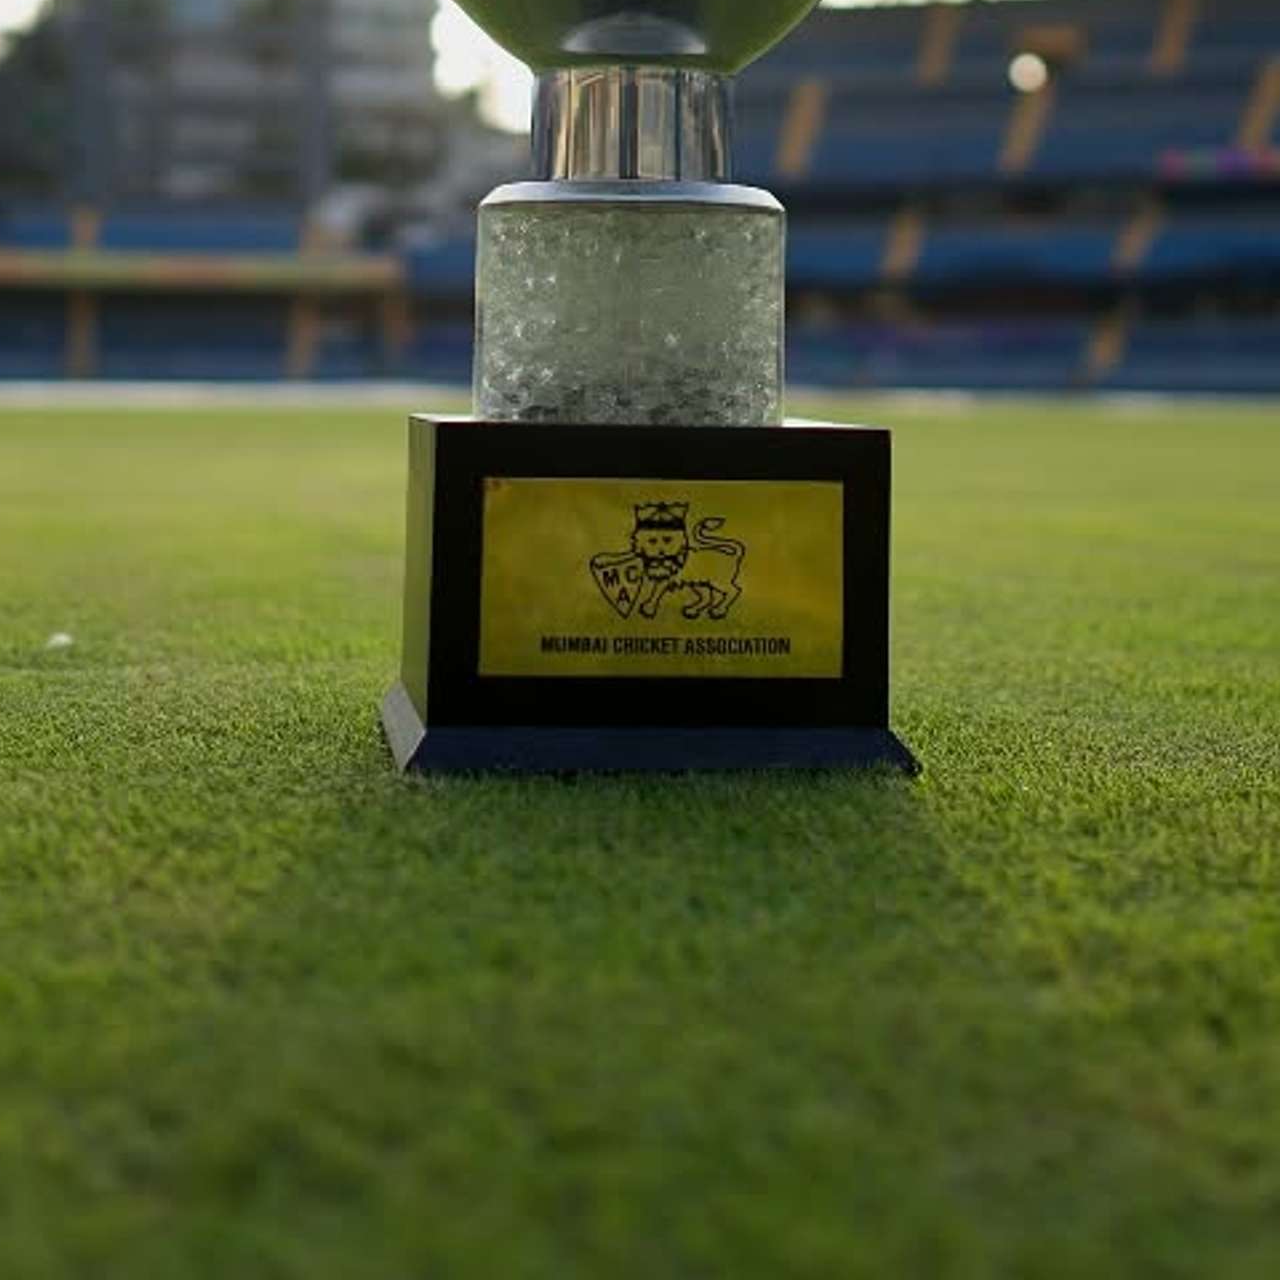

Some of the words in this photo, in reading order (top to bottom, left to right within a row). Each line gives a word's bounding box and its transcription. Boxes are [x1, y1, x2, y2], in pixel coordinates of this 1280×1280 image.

[602, 567, 620, 588] M
[624, 565, 639, 583] C
[616, 586, 631, 604] A
[540, 636, 607, 655] MUMBAI
[612, 636, 682, 655] CRICKET
[683, 637, 791, 656] ASSOCIATION
